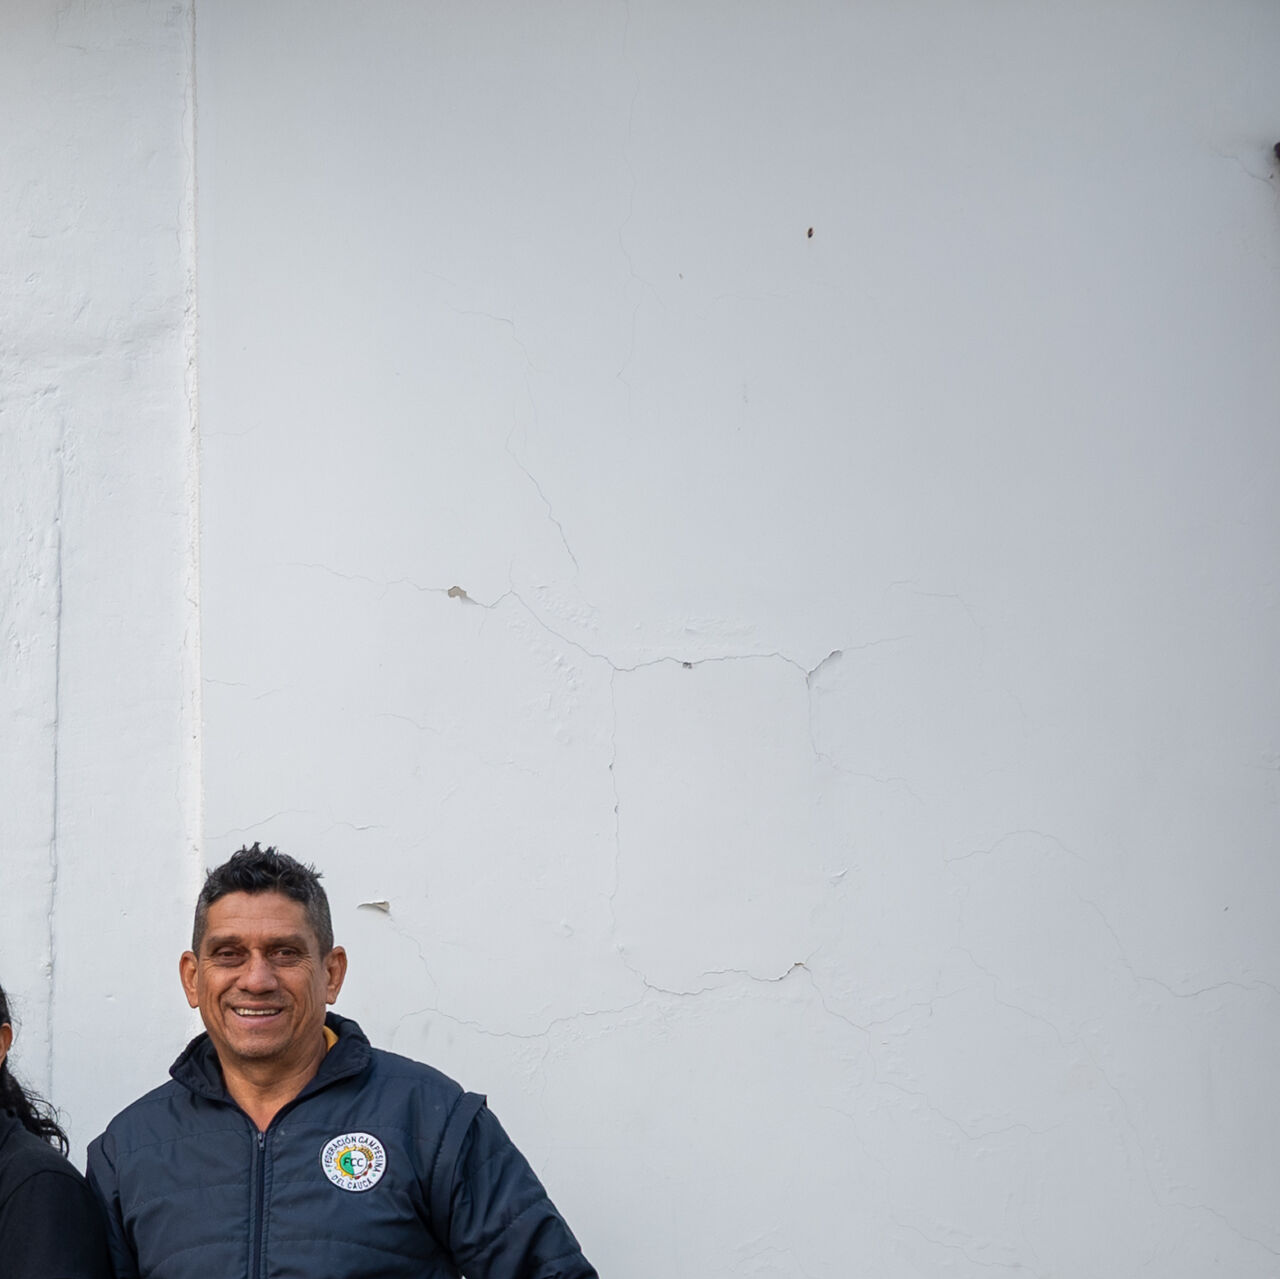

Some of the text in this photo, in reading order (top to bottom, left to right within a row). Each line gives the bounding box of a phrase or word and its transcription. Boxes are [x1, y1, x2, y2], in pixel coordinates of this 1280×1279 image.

[358, 1136, 383, 1172] CAMPESINA
[331, 1175, 373, 1189] DEL CAUCA
